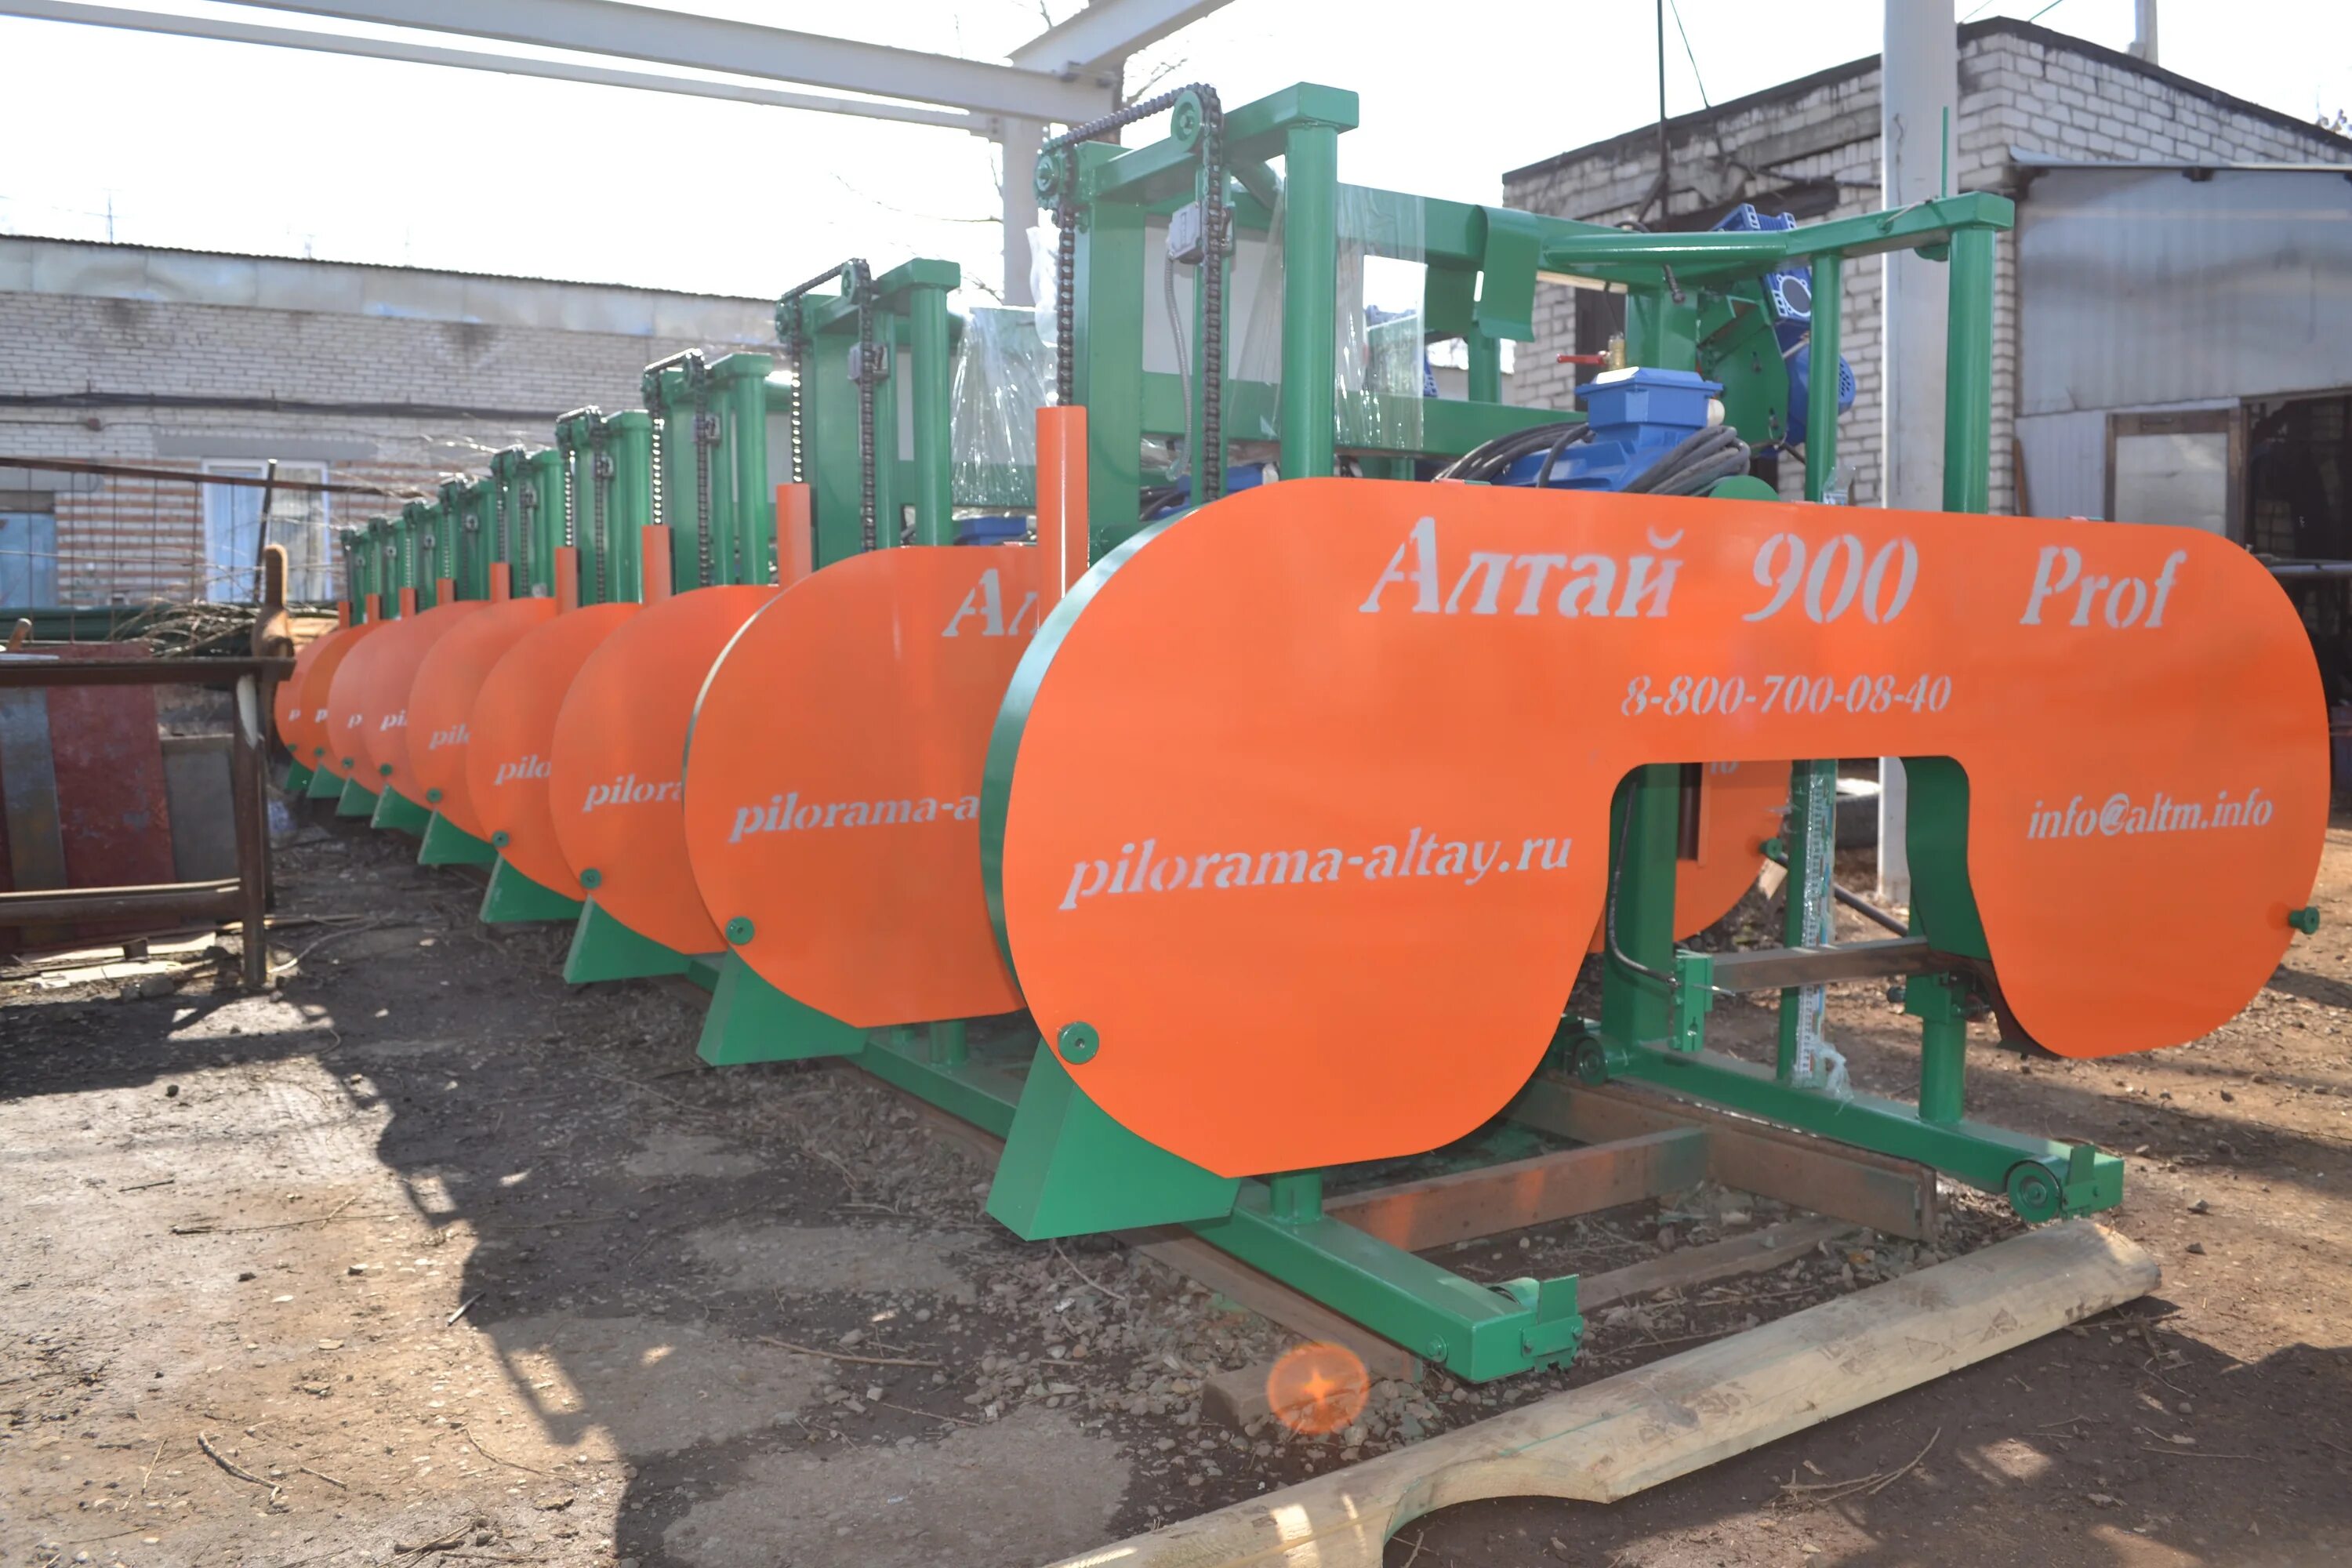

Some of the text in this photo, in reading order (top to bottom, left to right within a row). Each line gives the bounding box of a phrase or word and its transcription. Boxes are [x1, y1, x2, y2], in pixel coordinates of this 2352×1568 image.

[1359, 516, 2187, 627] Алтай 900 Prof
[1621, 674, 1951, 716] 8-800-700-08-40
[728, 792, 979, 843] pilorama-a
[2027, 787, 2273, 840] info@altm.info
[1058, 826, 1572, 910] pilorama-altay.ru
